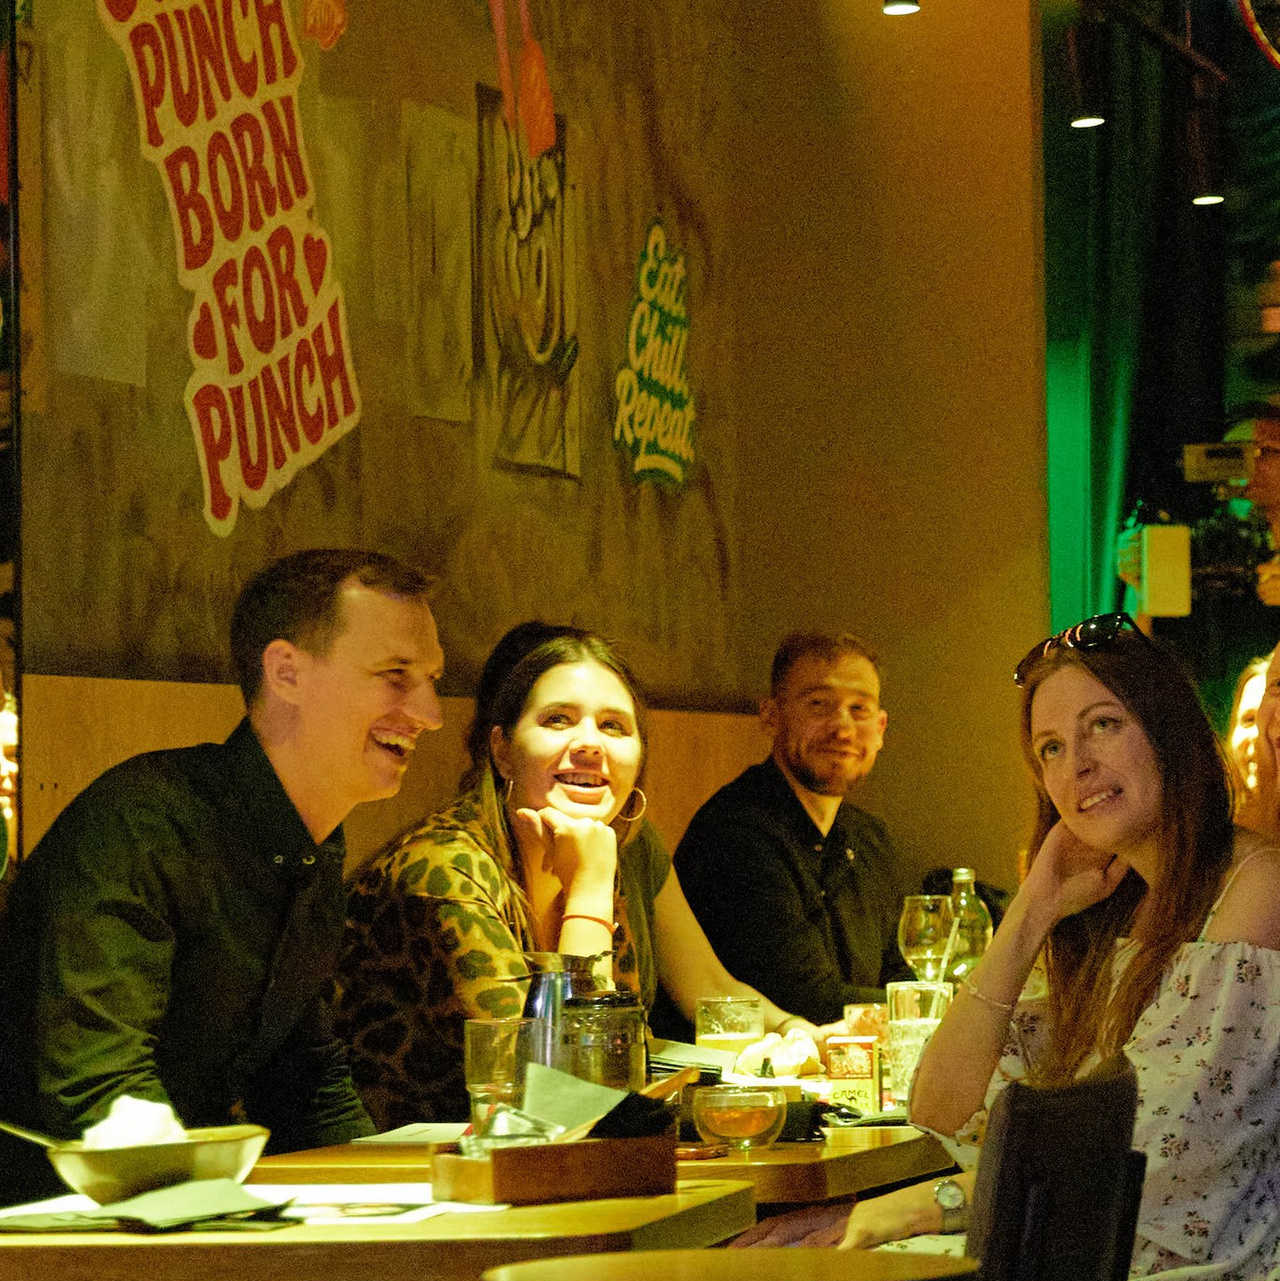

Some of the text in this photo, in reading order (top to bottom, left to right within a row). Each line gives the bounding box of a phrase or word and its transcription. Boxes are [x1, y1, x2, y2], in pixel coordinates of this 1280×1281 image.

[164, 95, 307, 270] BORN
[212, 225, 308, 375] FOR
[192, 297, 356, 521] PUNCH
[613, 368, 696, 463] Repeat
[832, 1089, 869, 1100] CAMEL
